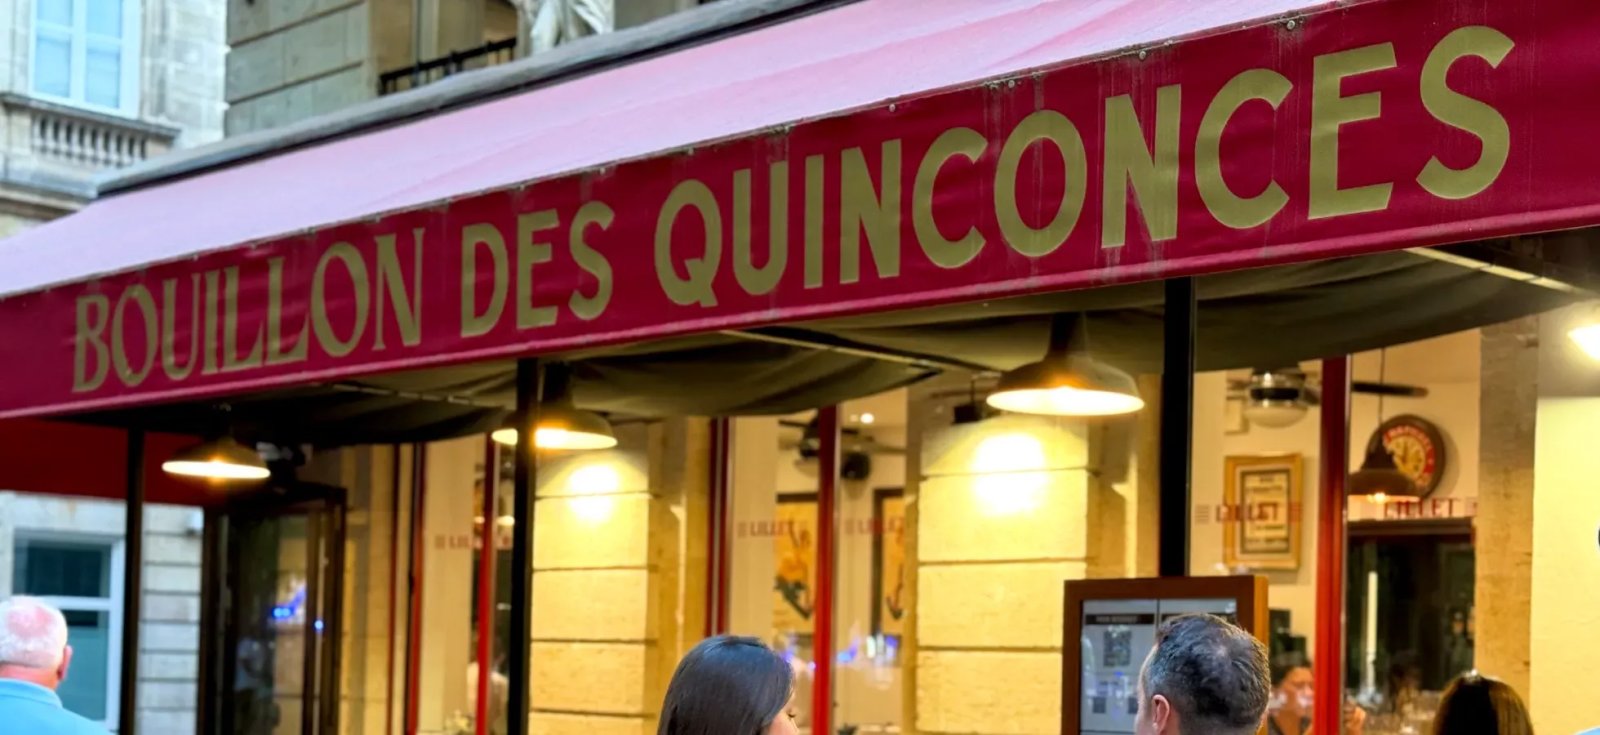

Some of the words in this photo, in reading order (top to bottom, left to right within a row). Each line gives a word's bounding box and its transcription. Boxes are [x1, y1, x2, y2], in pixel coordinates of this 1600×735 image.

[72, 228, 425, 393] BOUILLON
[461, 202, 613, 338] DES
[655, 27, 1512, 307] QUINCONCES
